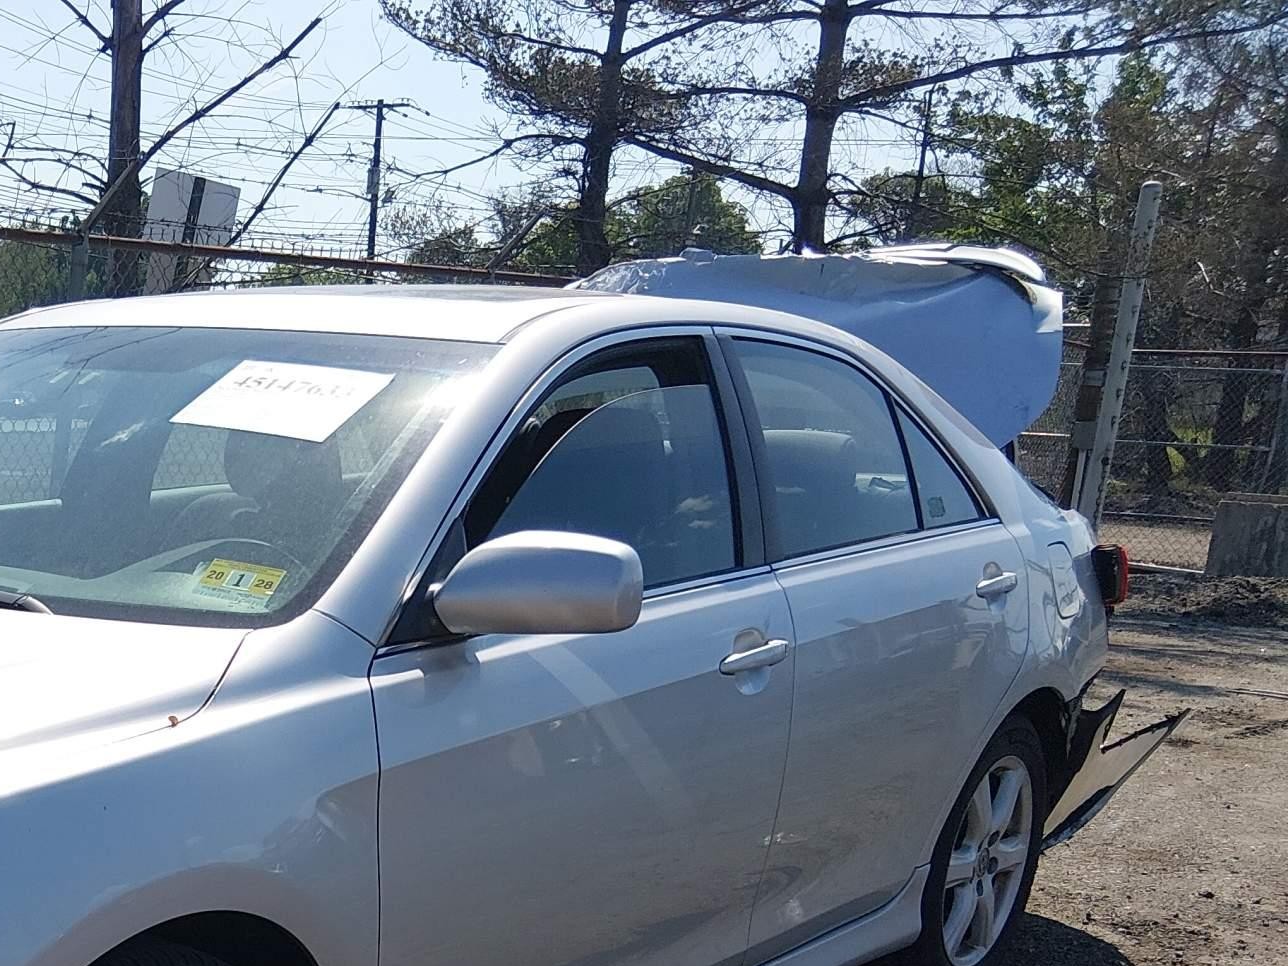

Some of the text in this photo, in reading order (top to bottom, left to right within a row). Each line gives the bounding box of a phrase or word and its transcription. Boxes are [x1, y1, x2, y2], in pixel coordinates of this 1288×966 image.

[207, 570, 273, 590] 20 1 28
